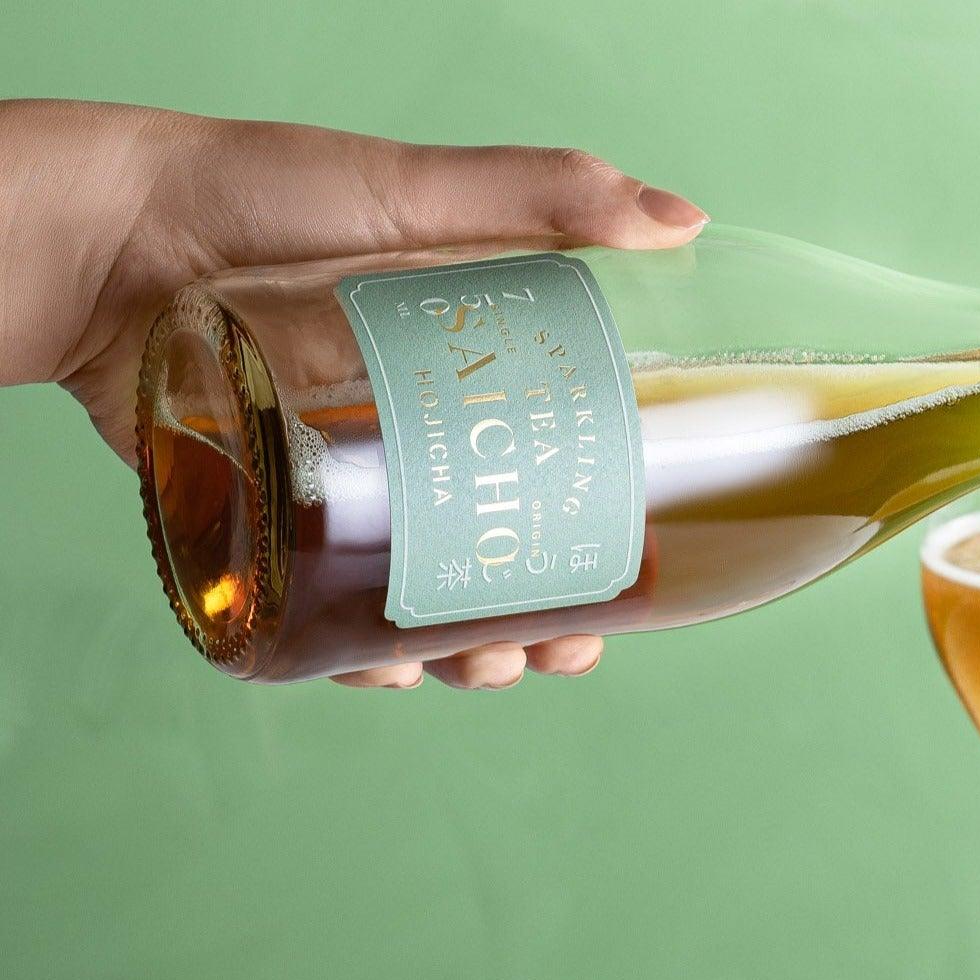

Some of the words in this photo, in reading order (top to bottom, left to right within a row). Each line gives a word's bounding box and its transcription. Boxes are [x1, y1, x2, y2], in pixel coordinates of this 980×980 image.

[414, 369, 452, 506] HOJICHA
[434, 304, 520, 566] SAICHO
[491, 304, 516, 353] SINGLE
[531, 500, 542, 558] ORIGIN
[524, 381, 560, 465] TEA
[534, 329, 597, 515] SPARKLING
[437, 543, 601, 590] ほうじ茶
